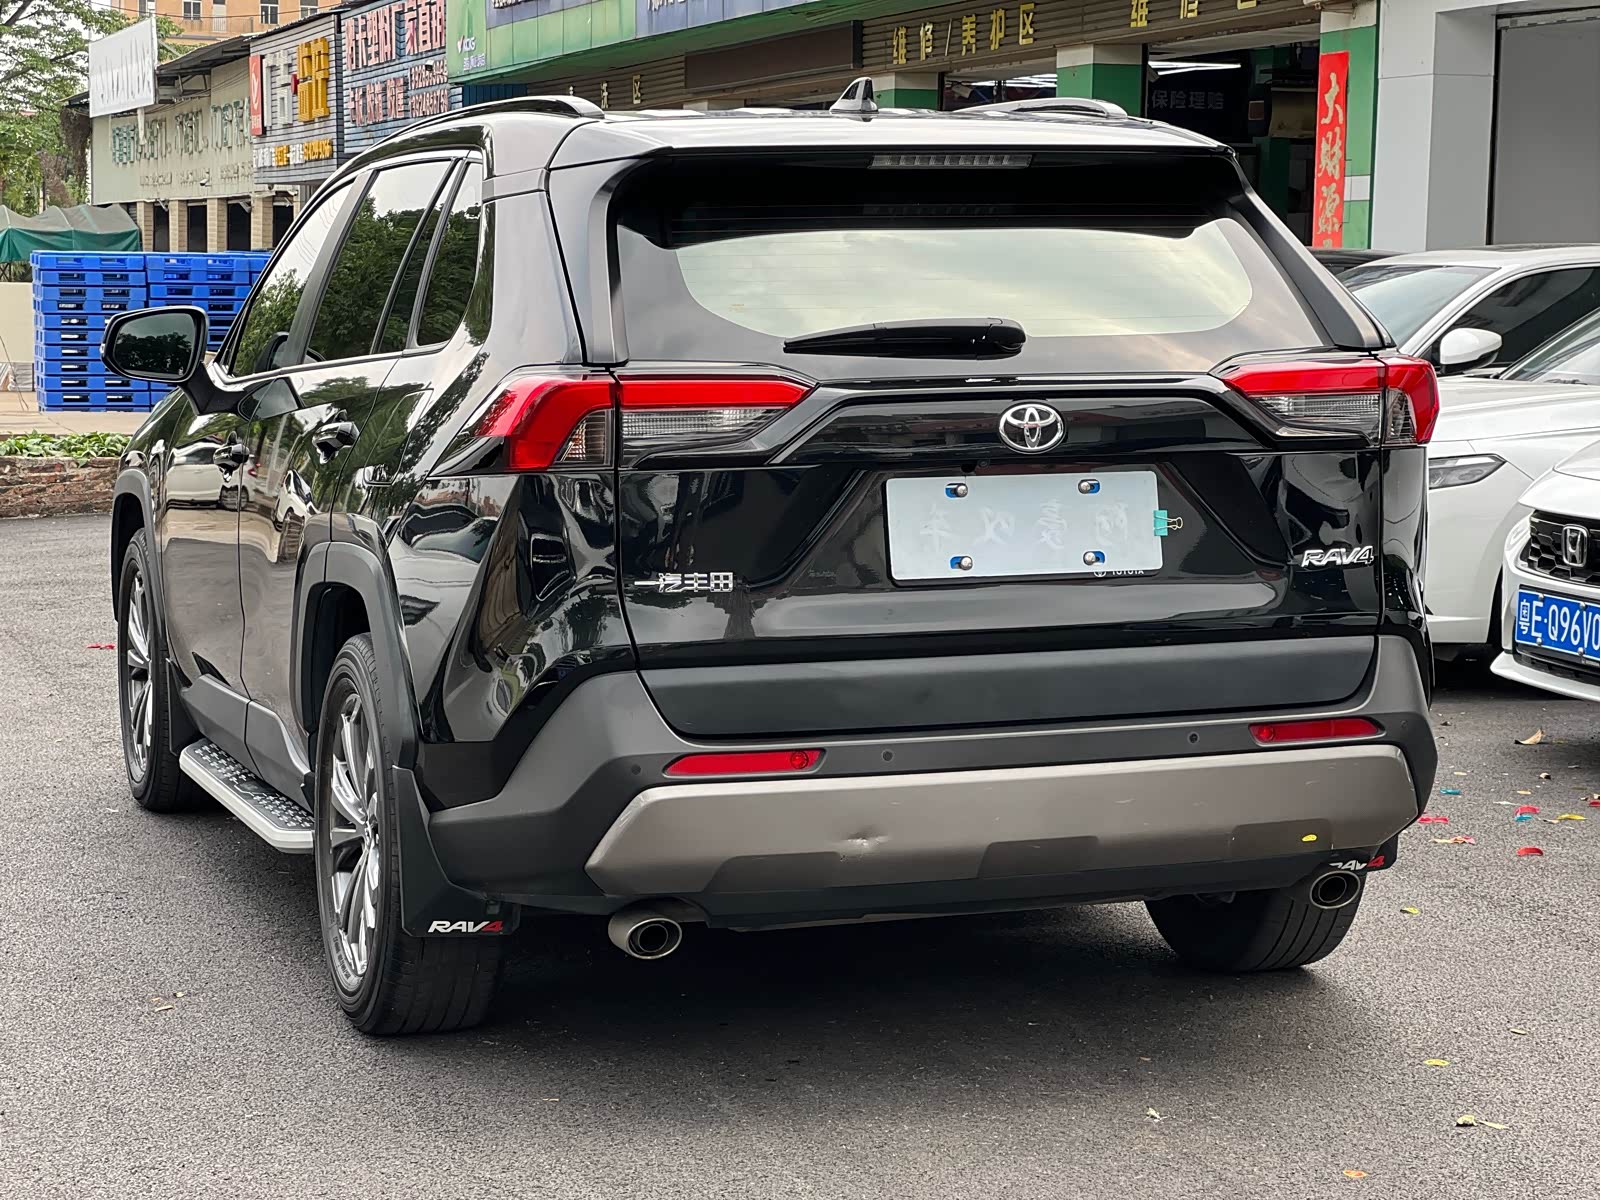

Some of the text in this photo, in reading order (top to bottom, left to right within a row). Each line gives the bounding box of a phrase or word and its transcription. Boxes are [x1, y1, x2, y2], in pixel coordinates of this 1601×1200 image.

[1151, 90, 1225, 110] 保险理赔
[1300, 545, 1375, 568] RAV4
[633, 571, 734, 593] 一汽丰田
[427, 920, 504, 934] RAV4
